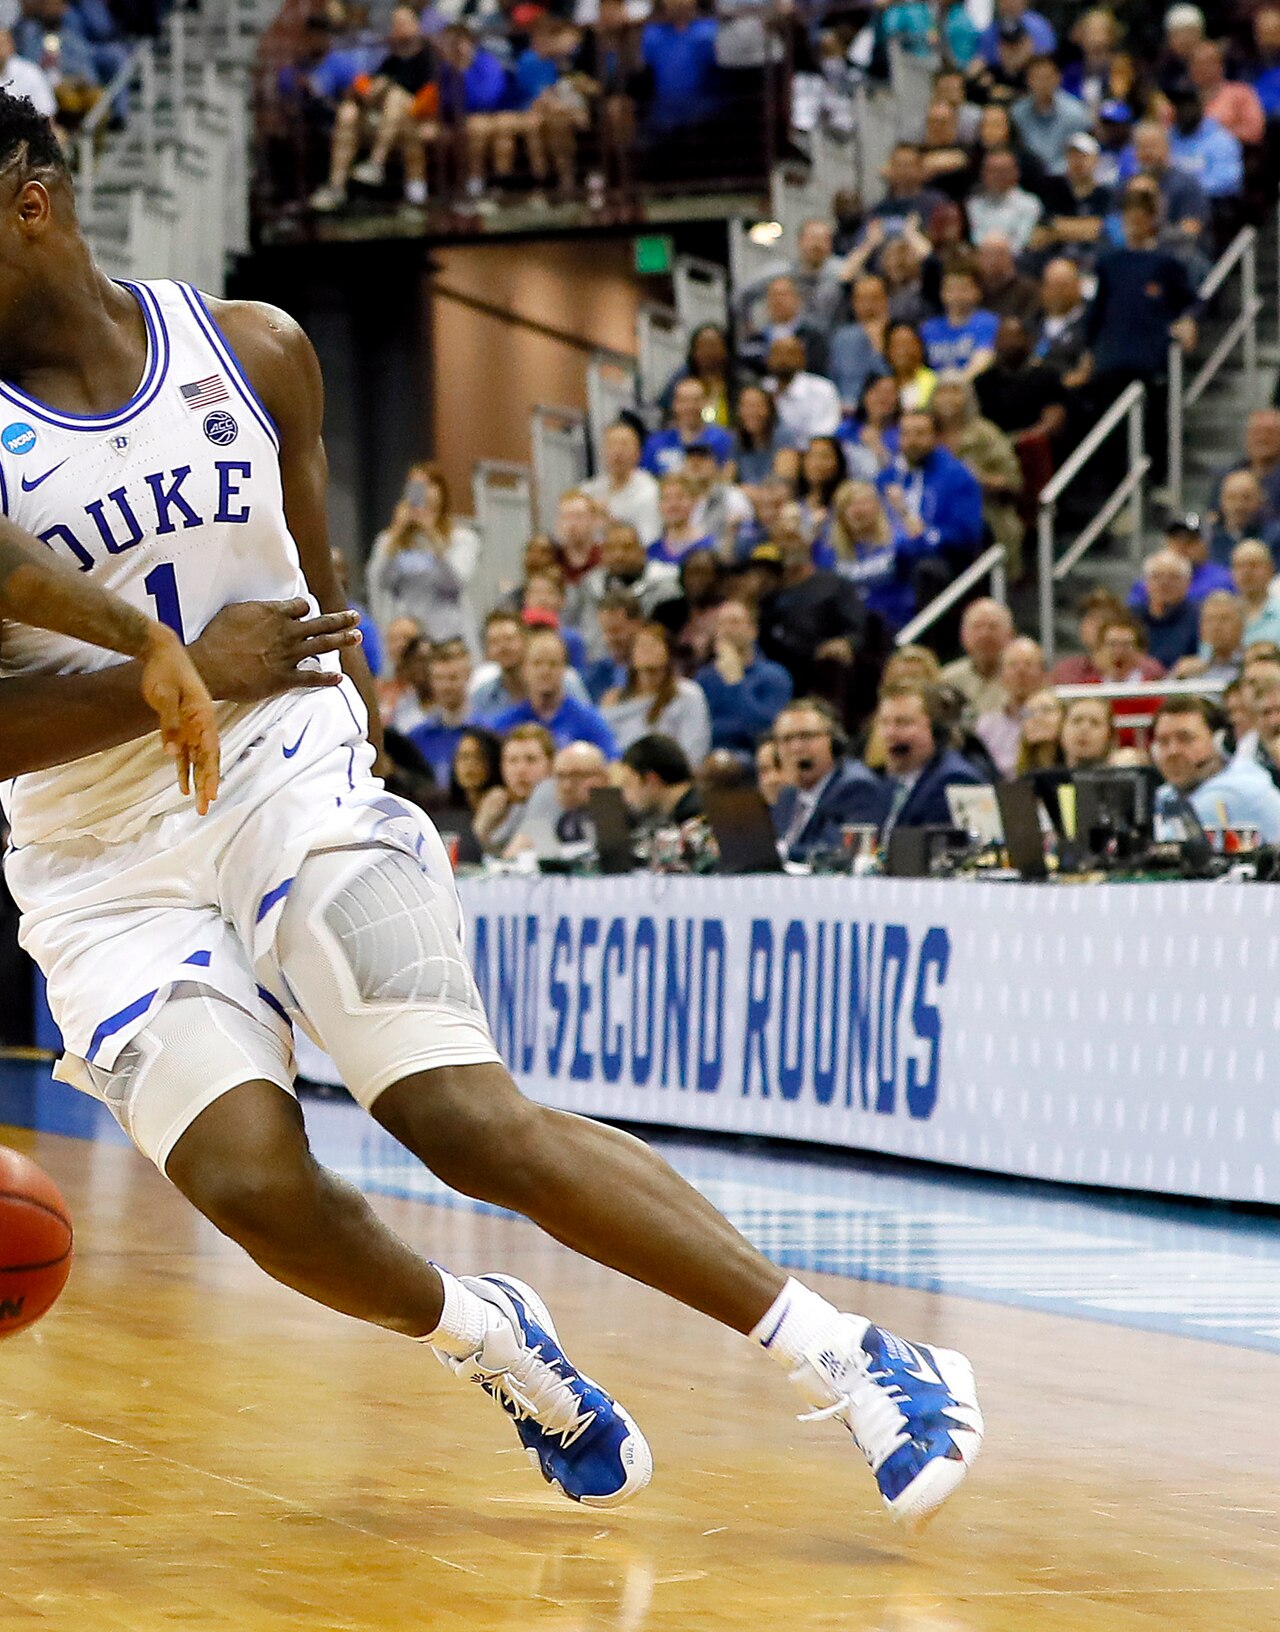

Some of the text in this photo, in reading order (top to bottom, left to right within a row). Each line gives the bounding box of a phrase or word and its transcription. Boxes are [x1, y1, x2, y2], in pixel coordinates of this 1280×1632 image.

[8, 430, 36, 449] NCAA
[210, 419, 233, 433] ACC
[38, 461, 252, 573] DUKE
[144, 562, 186, 646] 1
[547, 915, 726, 1093] SECOND
[741, 918, 951, 1121] ROUNDS
